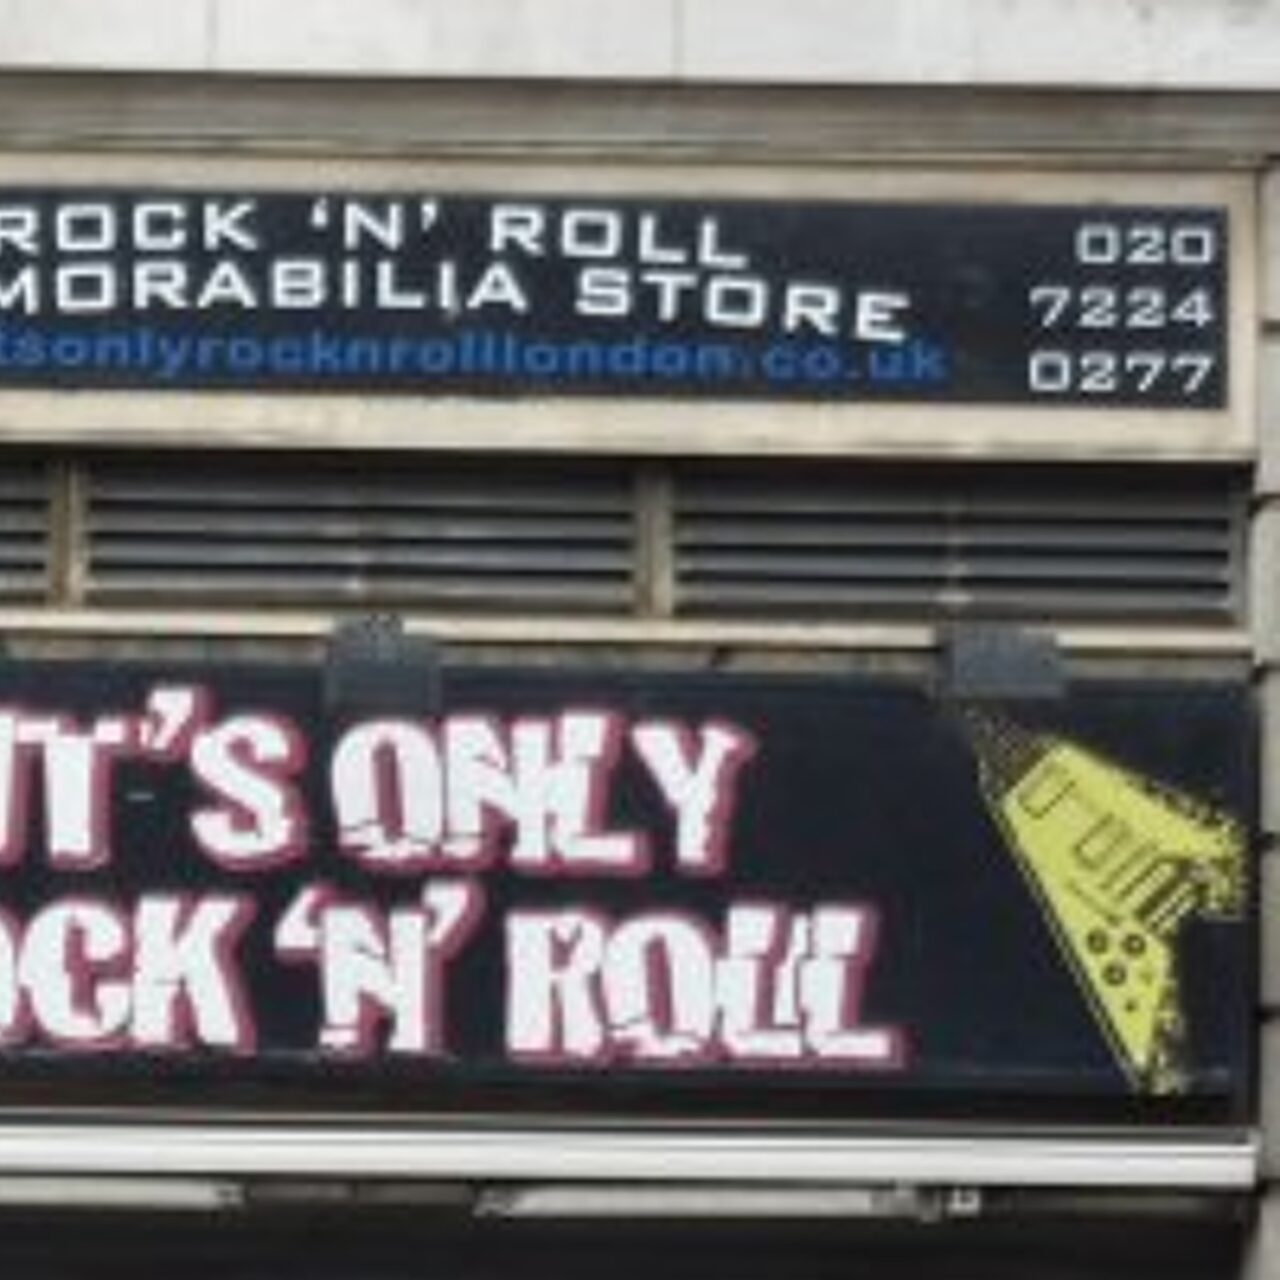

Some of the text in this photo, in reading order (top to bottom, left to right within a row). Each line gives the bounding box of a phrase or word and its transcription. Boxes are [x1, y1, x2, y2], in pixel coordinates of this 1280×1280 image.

[490, 203, 750, 266] ROLL
[1074, 224, 1216, 266] 020
[575, 266, 910, 342] STORE
[1030, 286, 1214, 330] 7224
[1028, 352, 1214, 394] 0277
[330, 708, 754, 872] ONLY
[504, 900, 904, 1066] ROLL
